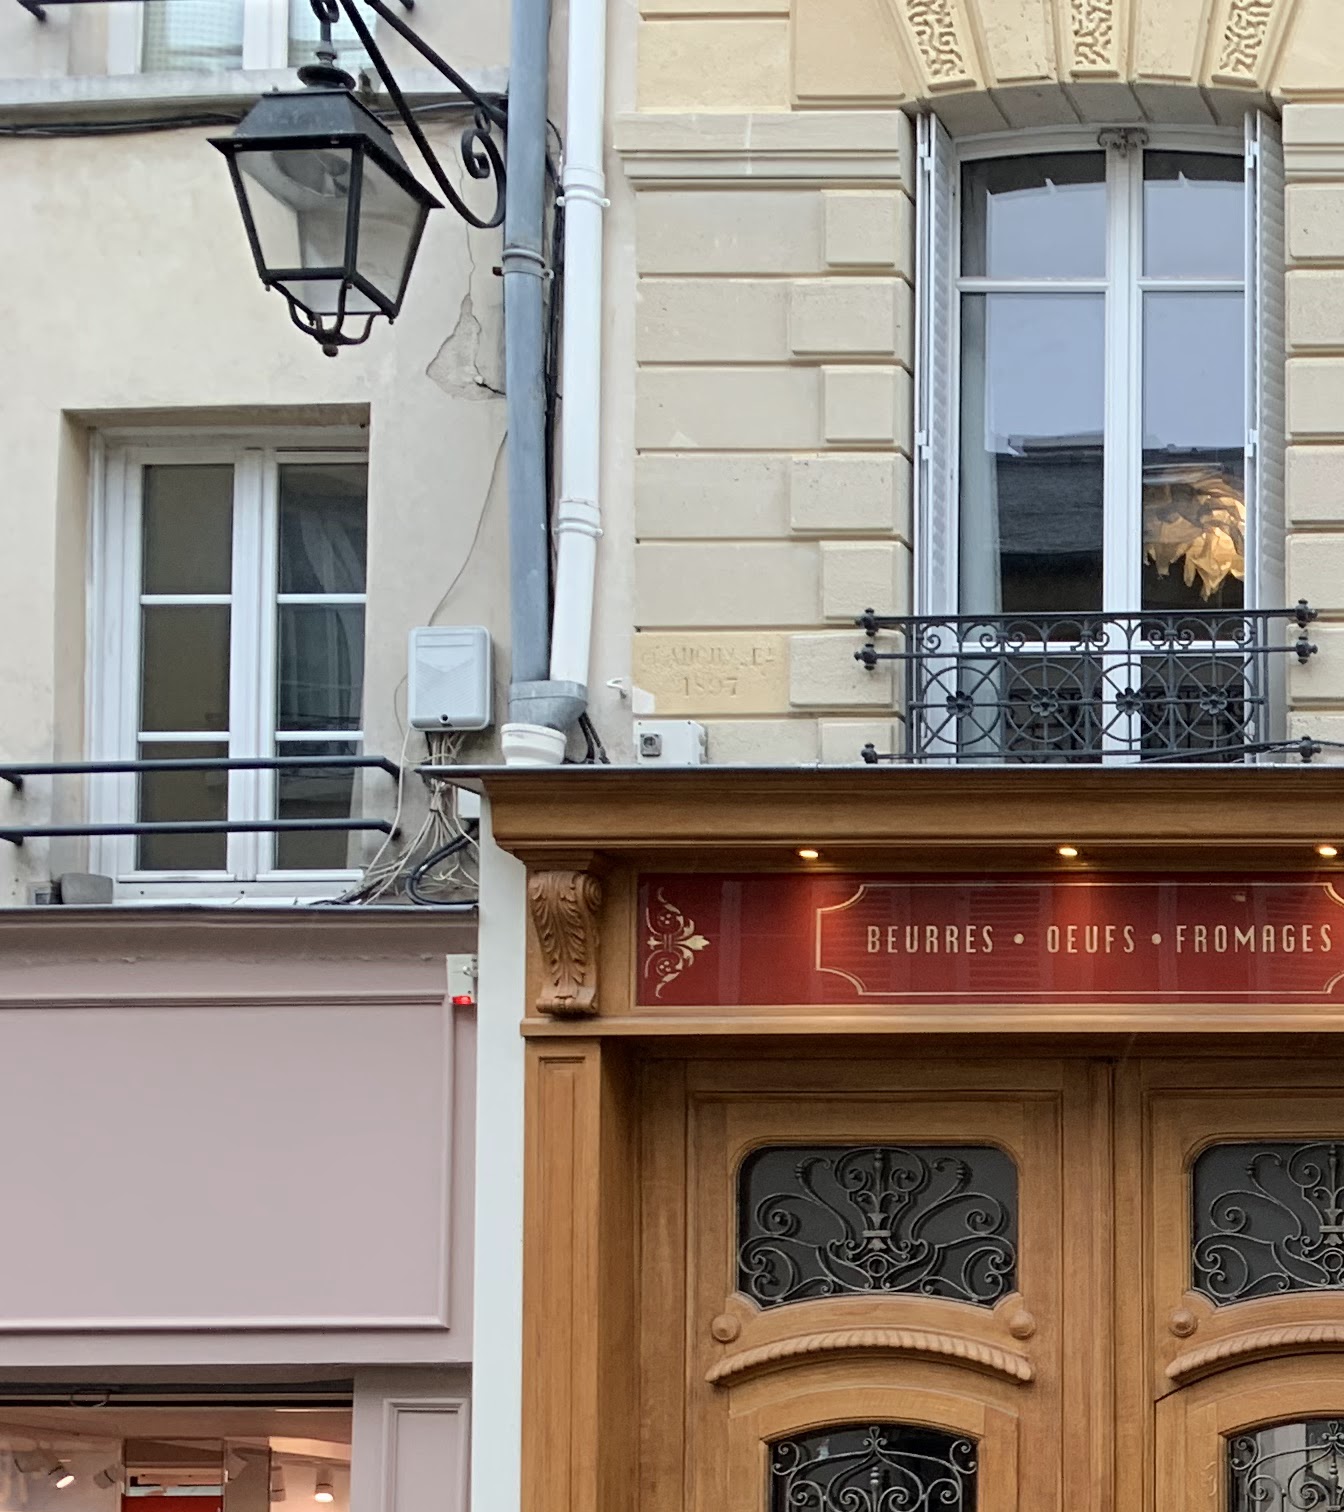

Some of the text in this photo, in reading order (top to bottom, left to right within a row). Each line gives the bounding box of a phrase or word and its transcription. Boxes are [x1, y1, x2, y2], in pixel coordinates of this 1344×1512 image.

[867, 923, 1333, 953] BEURRES OEUFS FROMAGES
